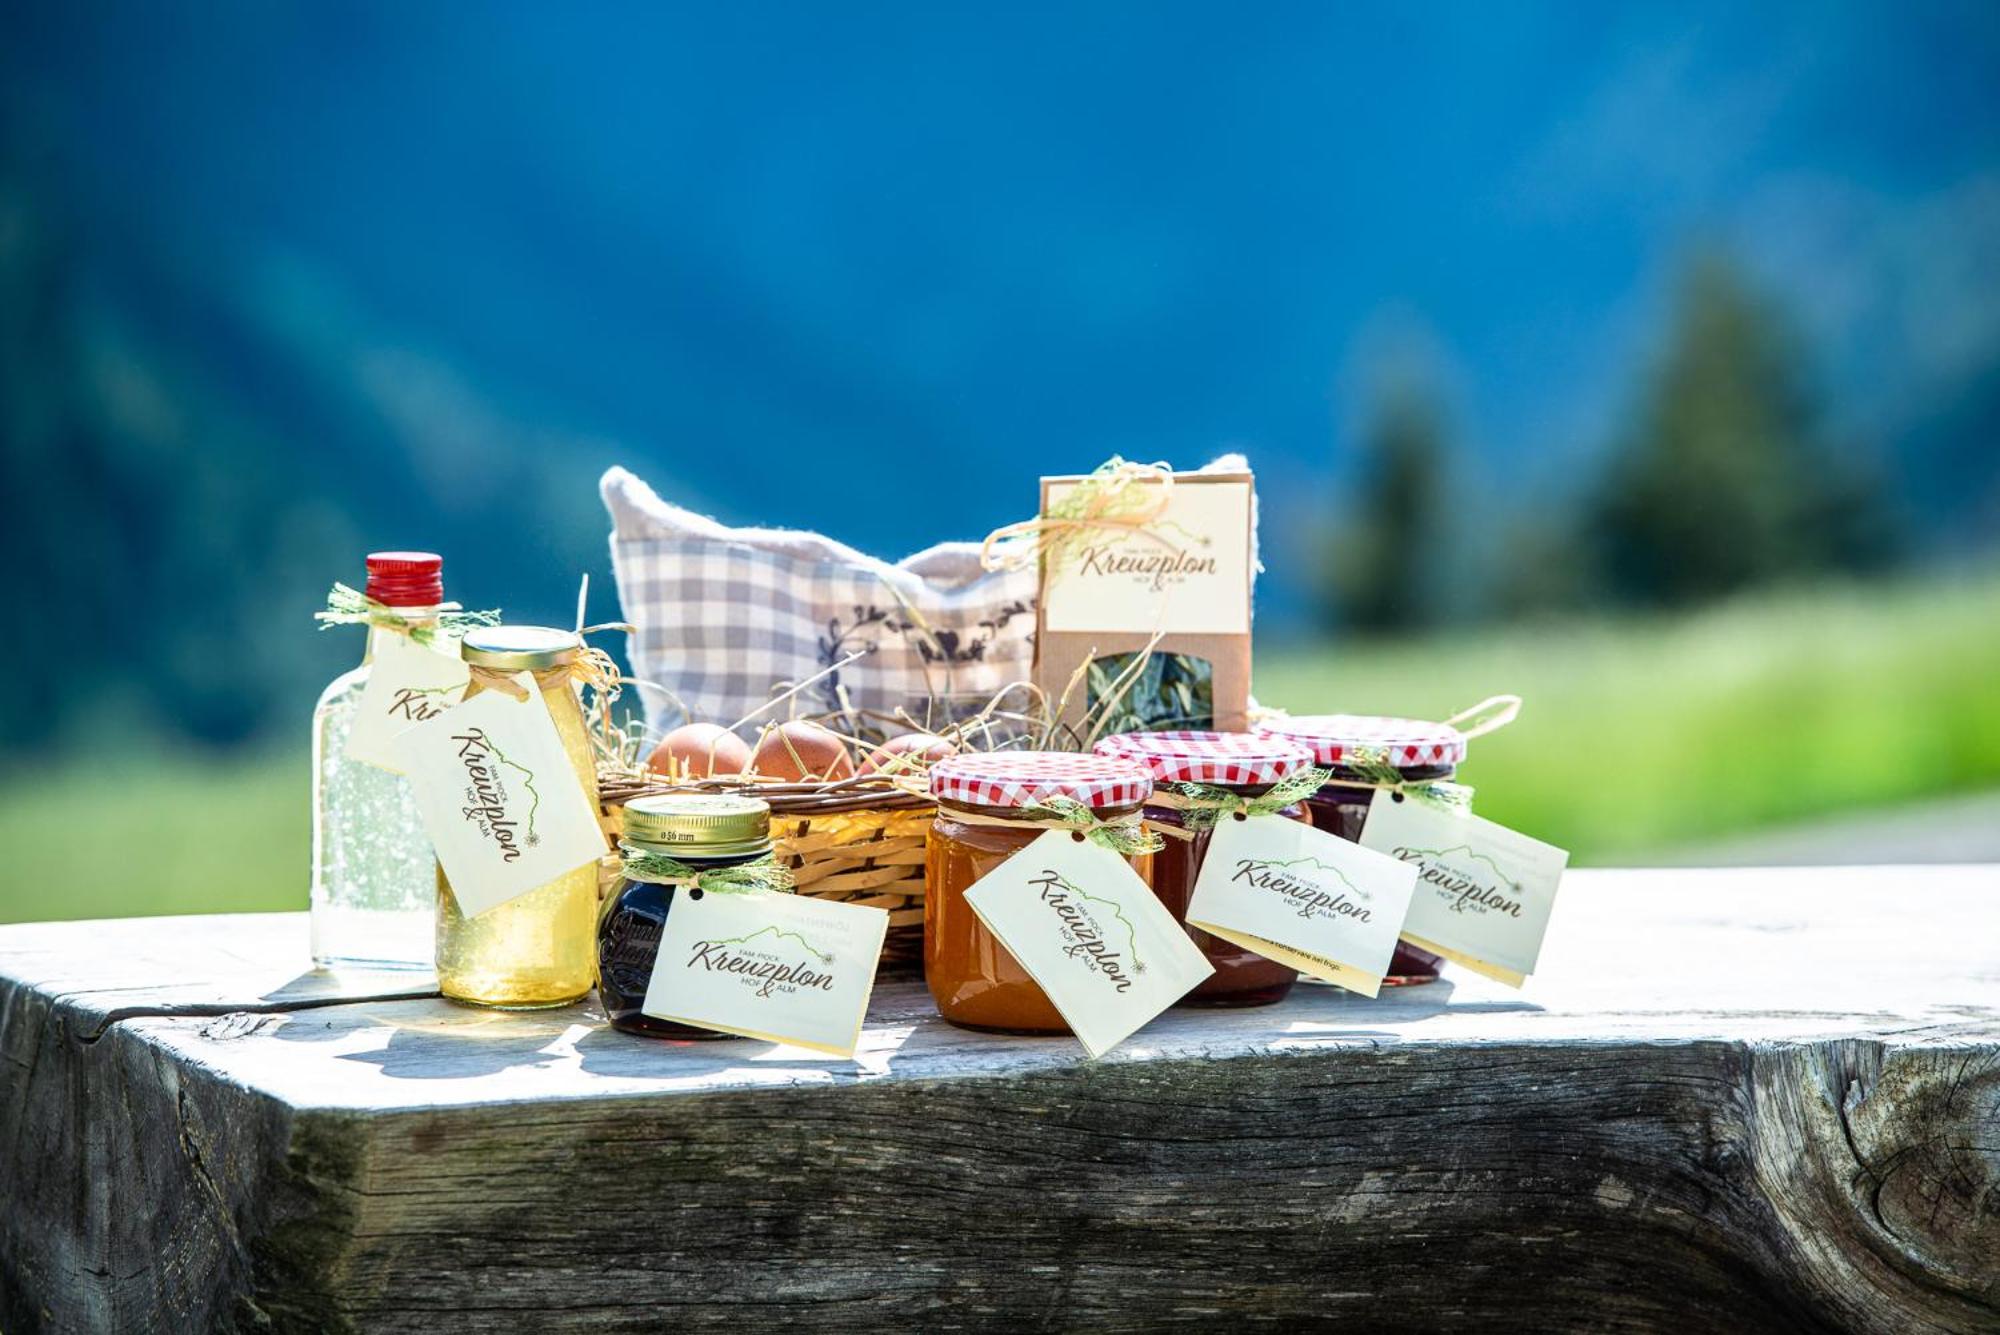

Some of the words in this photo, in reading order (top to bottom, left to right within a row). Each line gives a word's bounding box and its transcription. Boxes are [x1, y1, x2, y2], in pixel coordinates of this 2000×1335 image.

[1080, 546, 1216, 583] Kreuzplon
[450, 727, 521, 863] Kreuzplon
[1231, 859, 1372, 924] Kreuzplon
[1028, 870, 1131, 993] Kreuzplon
[687, 940, 833, 998] Kreuzplon
[740, 976, 761, 988] HOF
[775, 982, 797, 994] ALM
